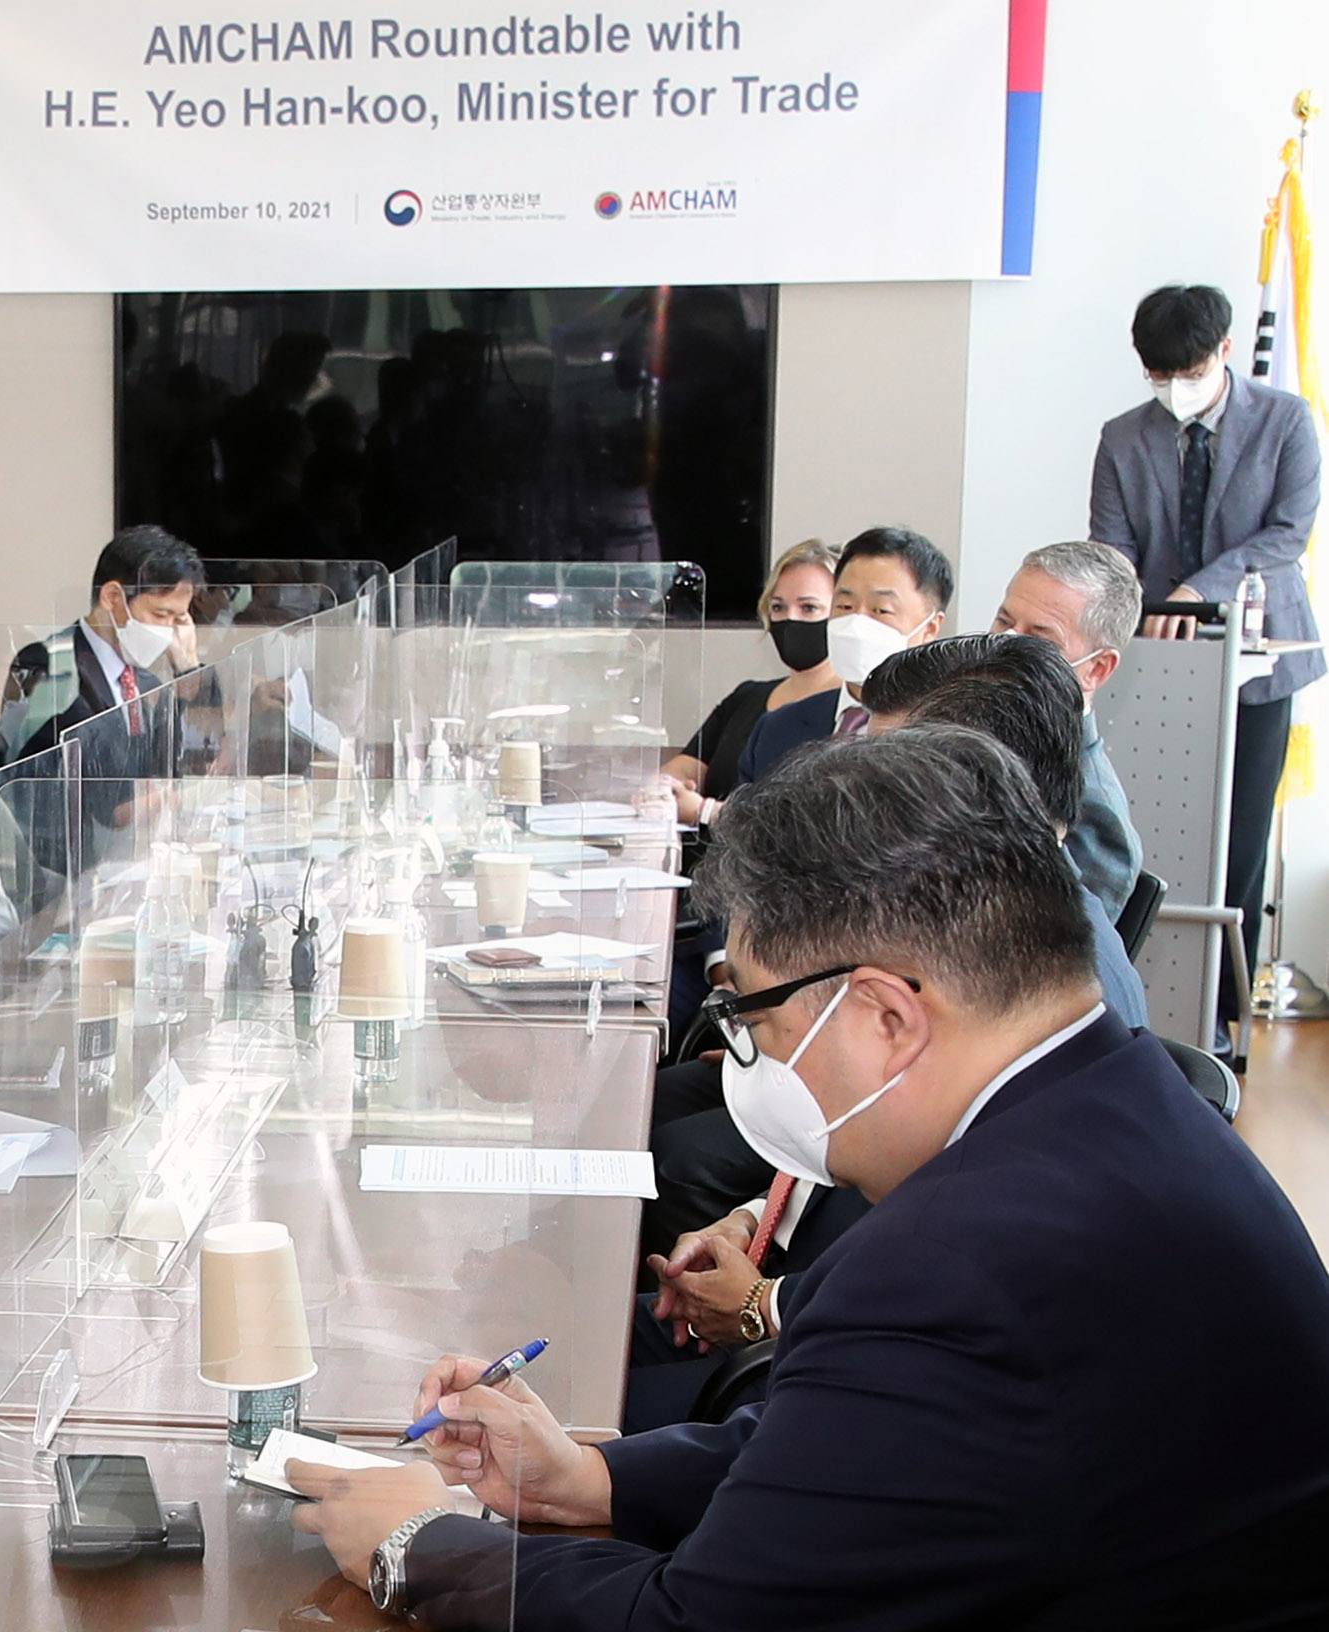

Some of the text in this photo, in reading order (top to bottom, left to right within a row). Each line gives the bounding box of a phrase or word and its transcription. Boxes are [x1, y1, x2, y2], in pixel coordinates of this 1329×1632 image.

[144, 10, 741, 65] AMCHAM Roundtable with
[44, 72, 860, 130] H.E. Yeo Han-koo, Minister for Trade
[431, 192, 542, 211] 산업통상자원부
[629, 189, 737, 211] AMCHAM
[146, 202, 332, 224] September 10, 2021
